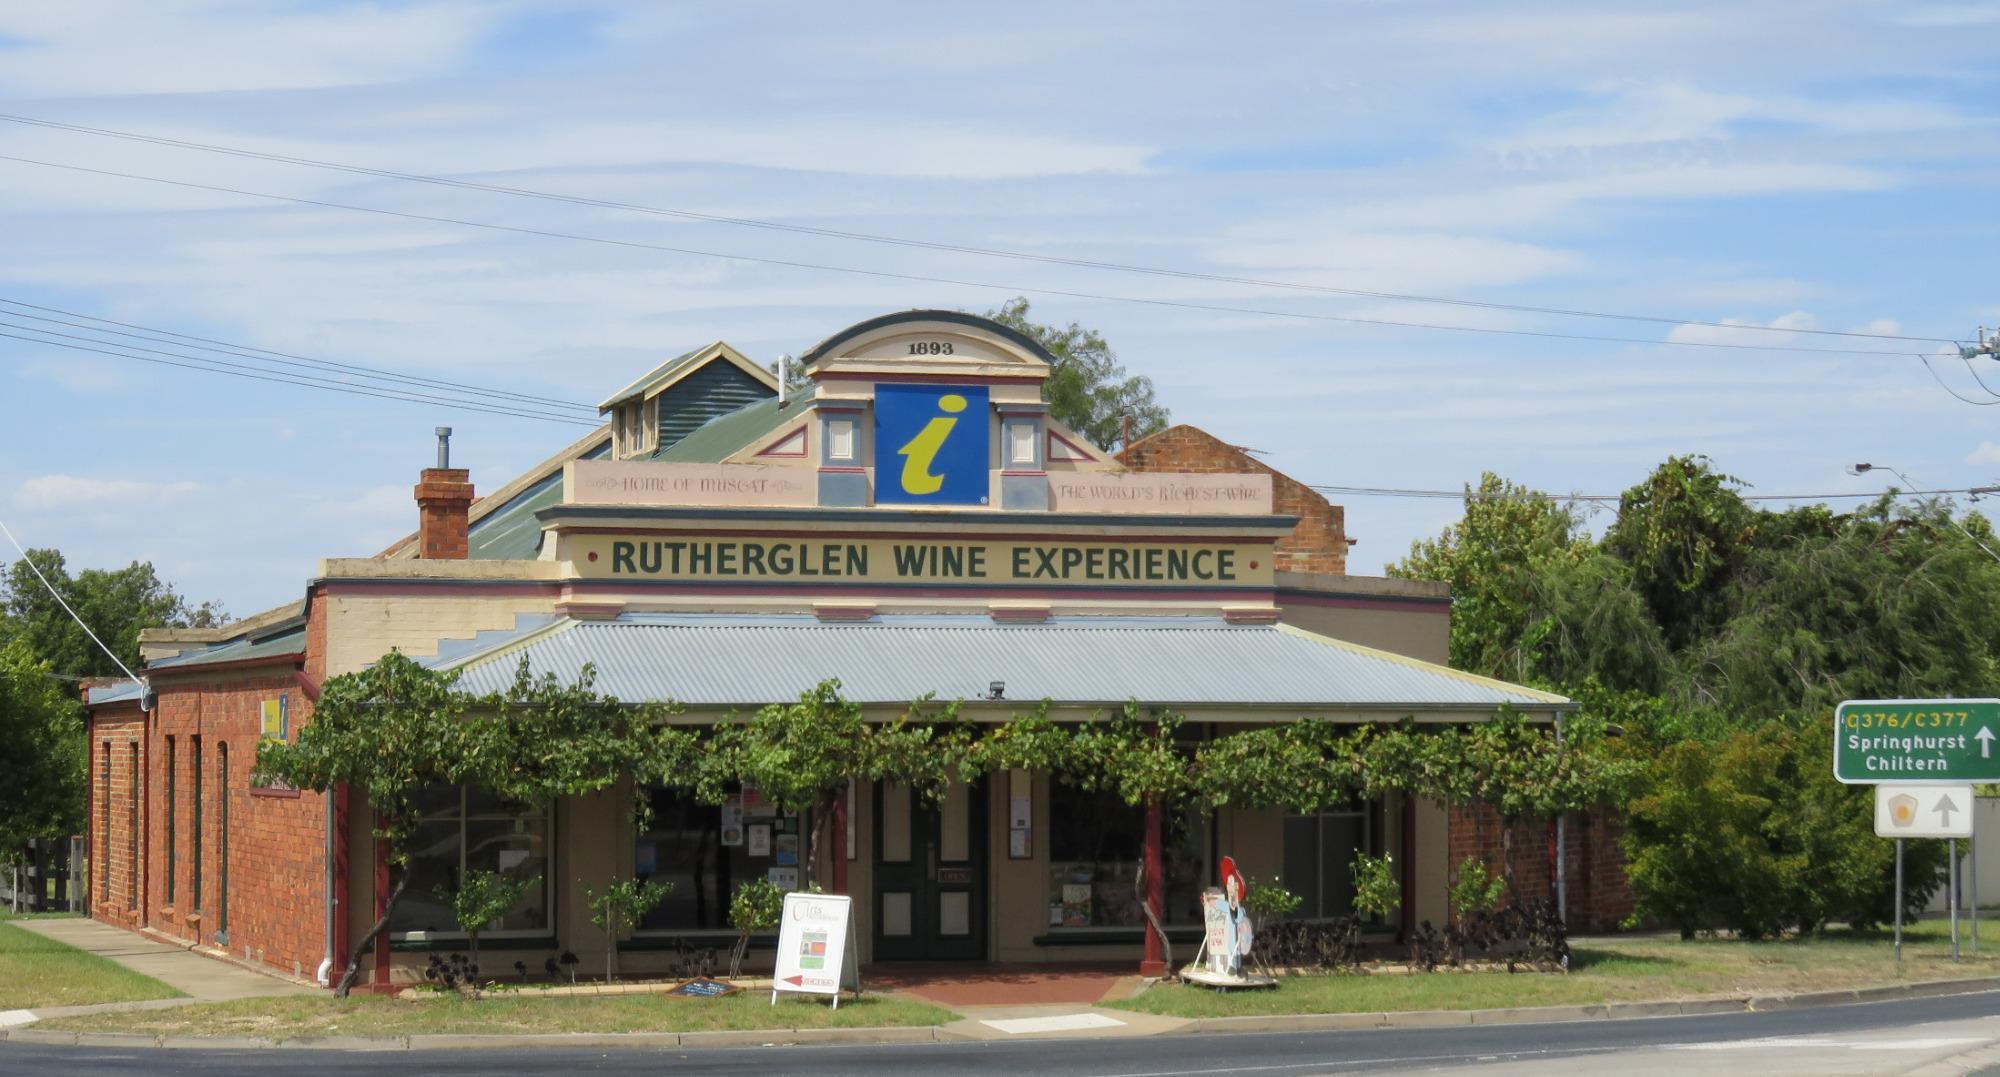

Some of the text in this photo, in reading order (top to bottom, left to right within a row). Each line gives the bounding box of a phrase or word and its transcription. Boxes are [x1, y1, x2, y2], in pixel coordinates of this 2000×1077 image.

[908, 342, 954, 355] 1893
[612, 541, 1236, 580] RUTHERGLEN WINE EXPERIENCE
[1847, 712, 1968, 728] C376/C377
[1848, 734, 1965, 753] Springhurst
[1866, 755, 1948, 771] Chiltern
